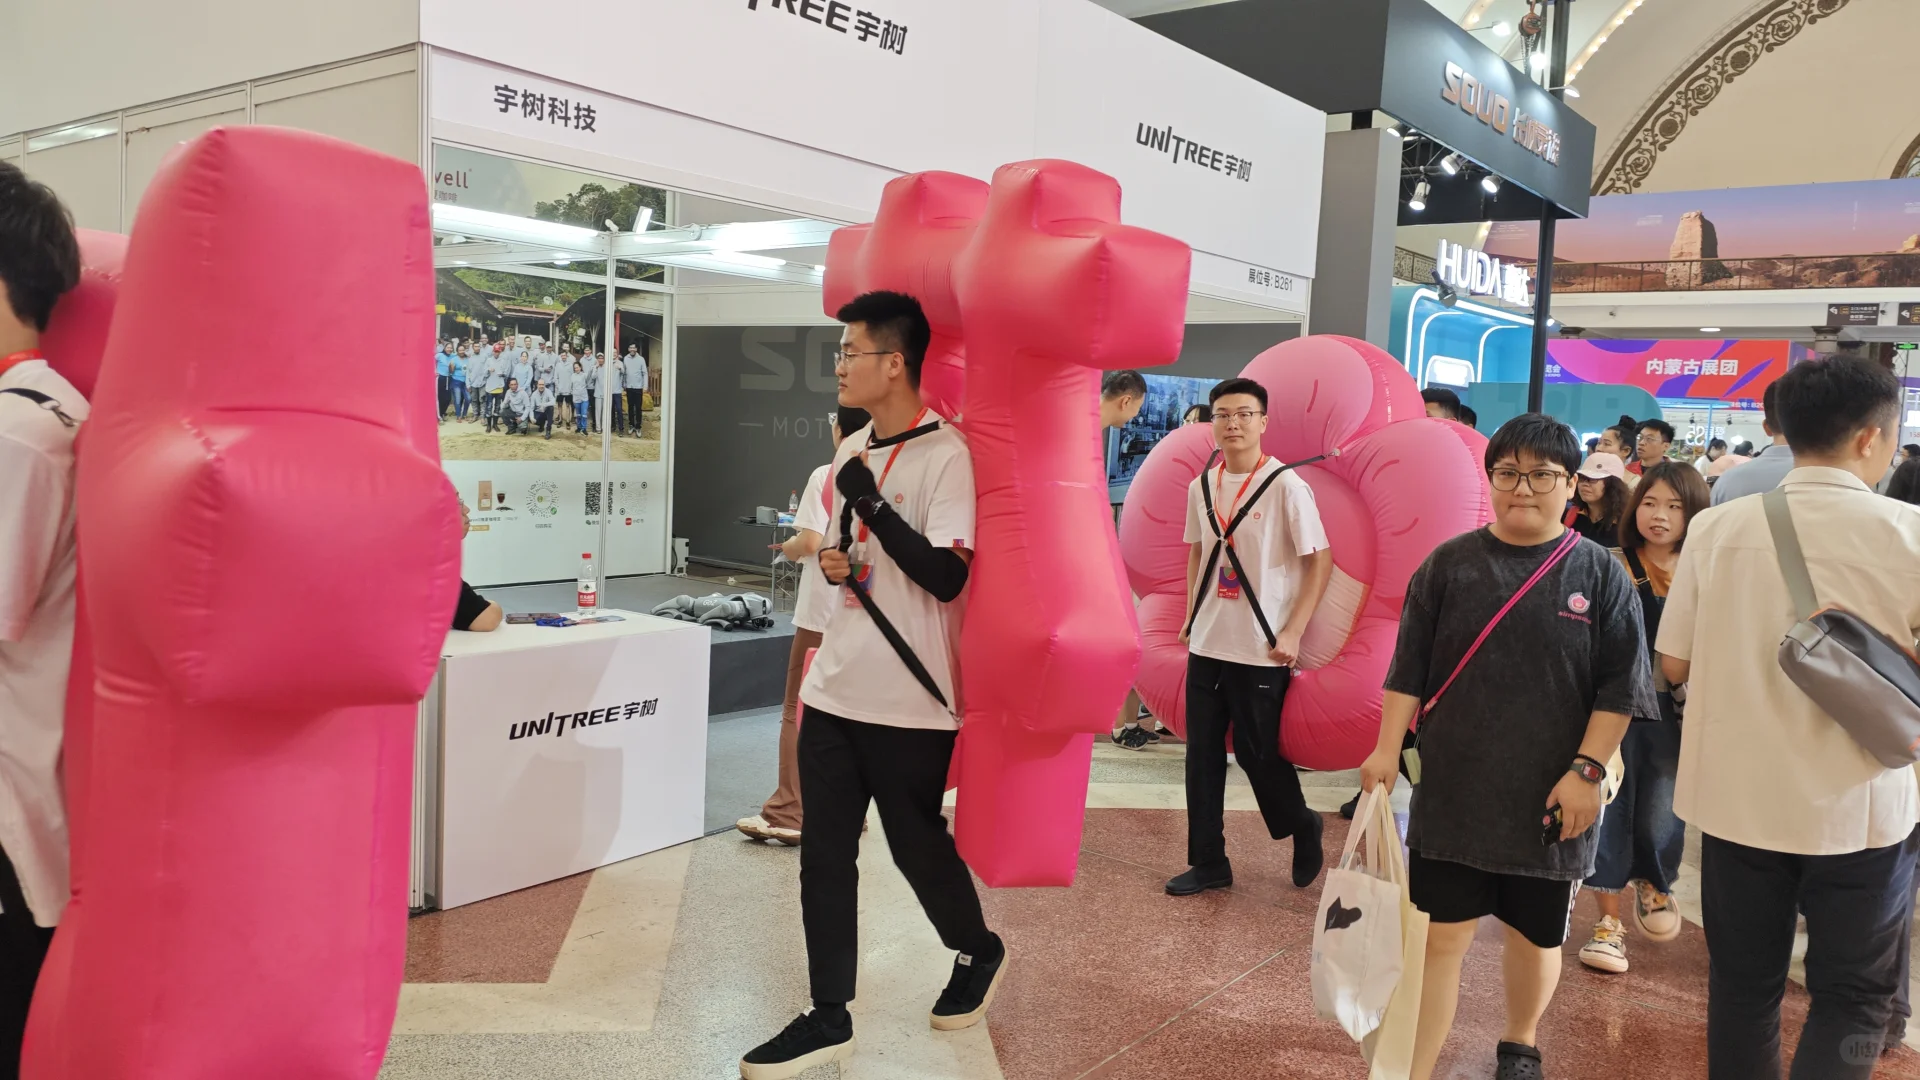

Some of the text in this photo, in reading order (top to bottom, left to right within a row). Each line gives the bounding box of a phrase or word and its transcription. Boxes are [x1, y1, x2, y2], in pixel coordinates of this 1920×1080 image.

[493, 84, 597, 133] 宇树科技
[1437, 238, 1503, 299] HUIDA
[1645, 358, 1739, 376] 内蒙古展团
